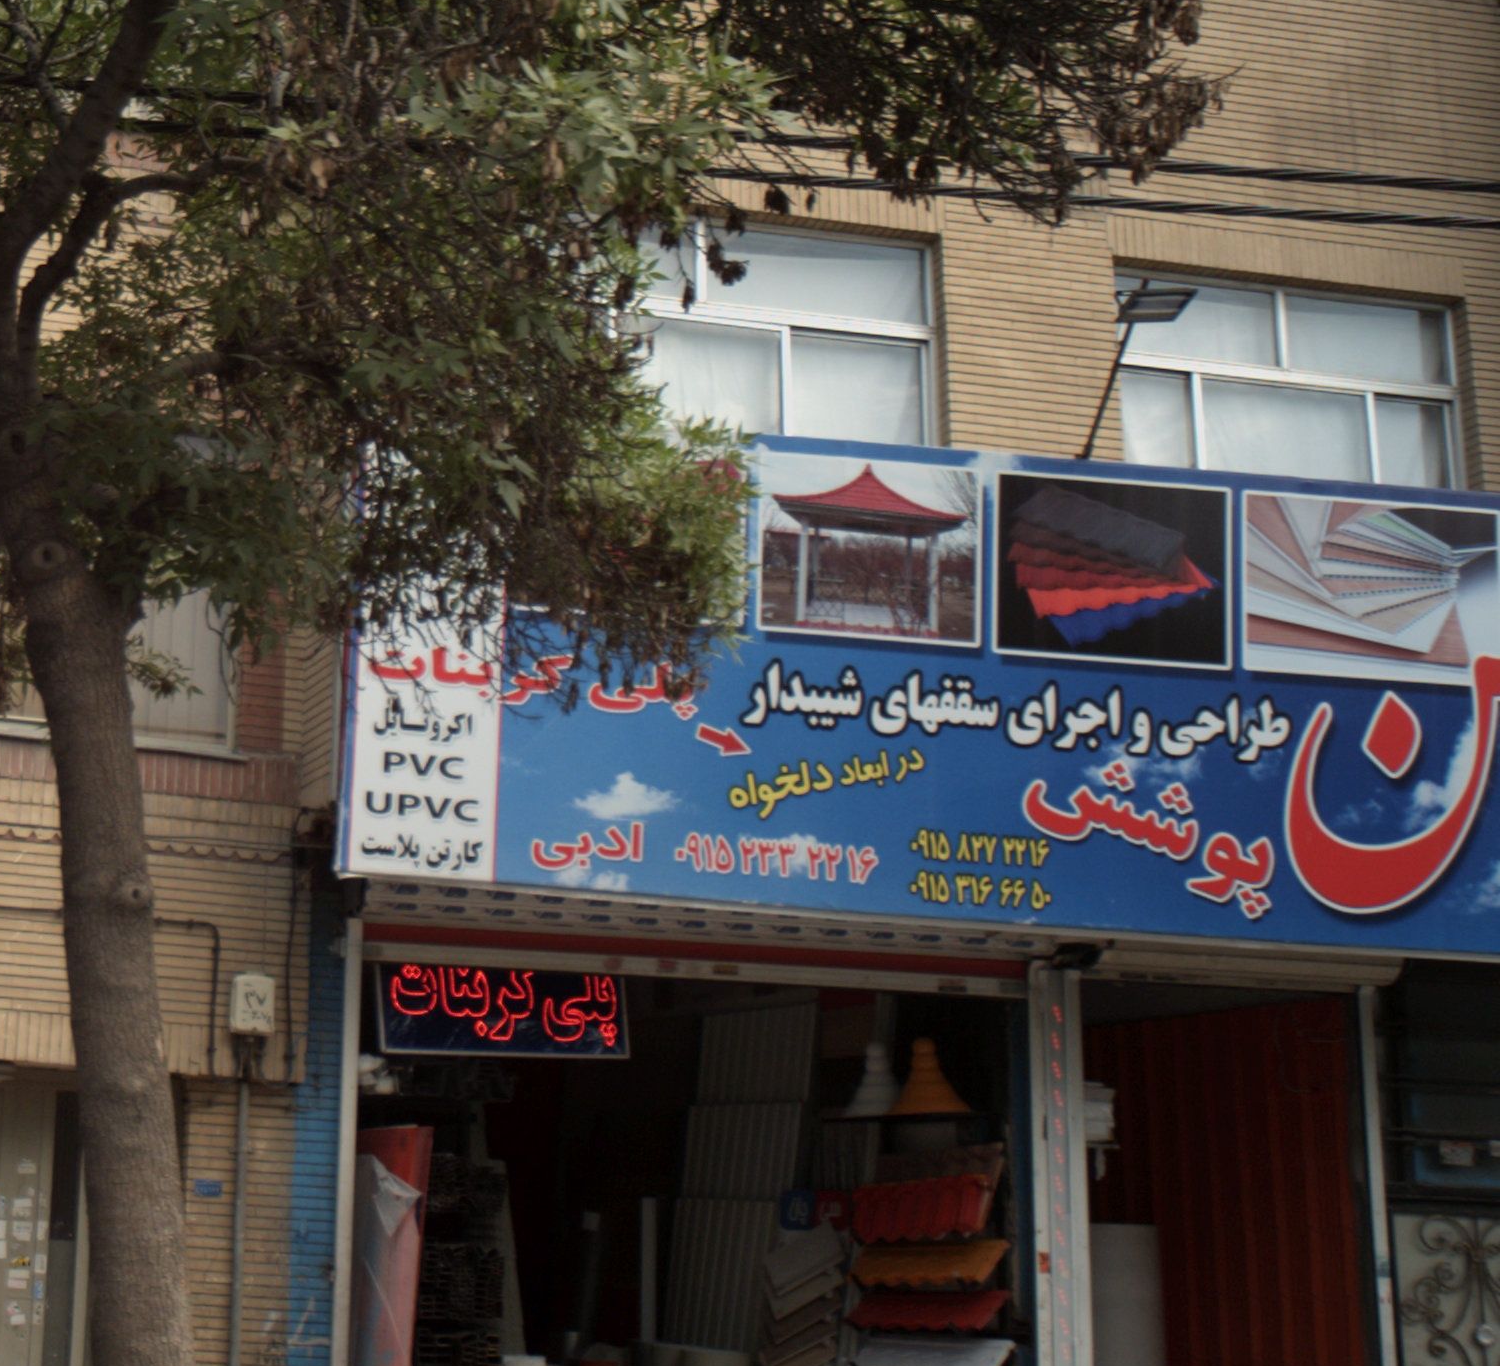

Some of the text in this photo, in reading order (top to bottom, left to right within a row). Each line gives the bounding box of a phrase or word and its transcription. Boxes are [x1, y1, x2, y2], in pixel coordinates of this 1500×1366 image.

[740, 657, 1292, 763] طراحی و اجرای سقفهای شیبدار
[383, 751, 465, 780] PVC
[728, 748, 926, 820] در ابعاد دلخواه
[365, 790, 480, 823] UPVC
[359, 833, 484, 871] کارتن پلاست
[531, 821, 644, 869] ادبی
[674, 832, 735, 875] ۰۹۱۵
[910, 828, 950, 861] ۰۹۱۵
[1021, 760, 1274, 920] پوشش
[909, 870, 950, 904] ۰۹۱۵
[389, 963, 619, 1047] پلی کربنات
